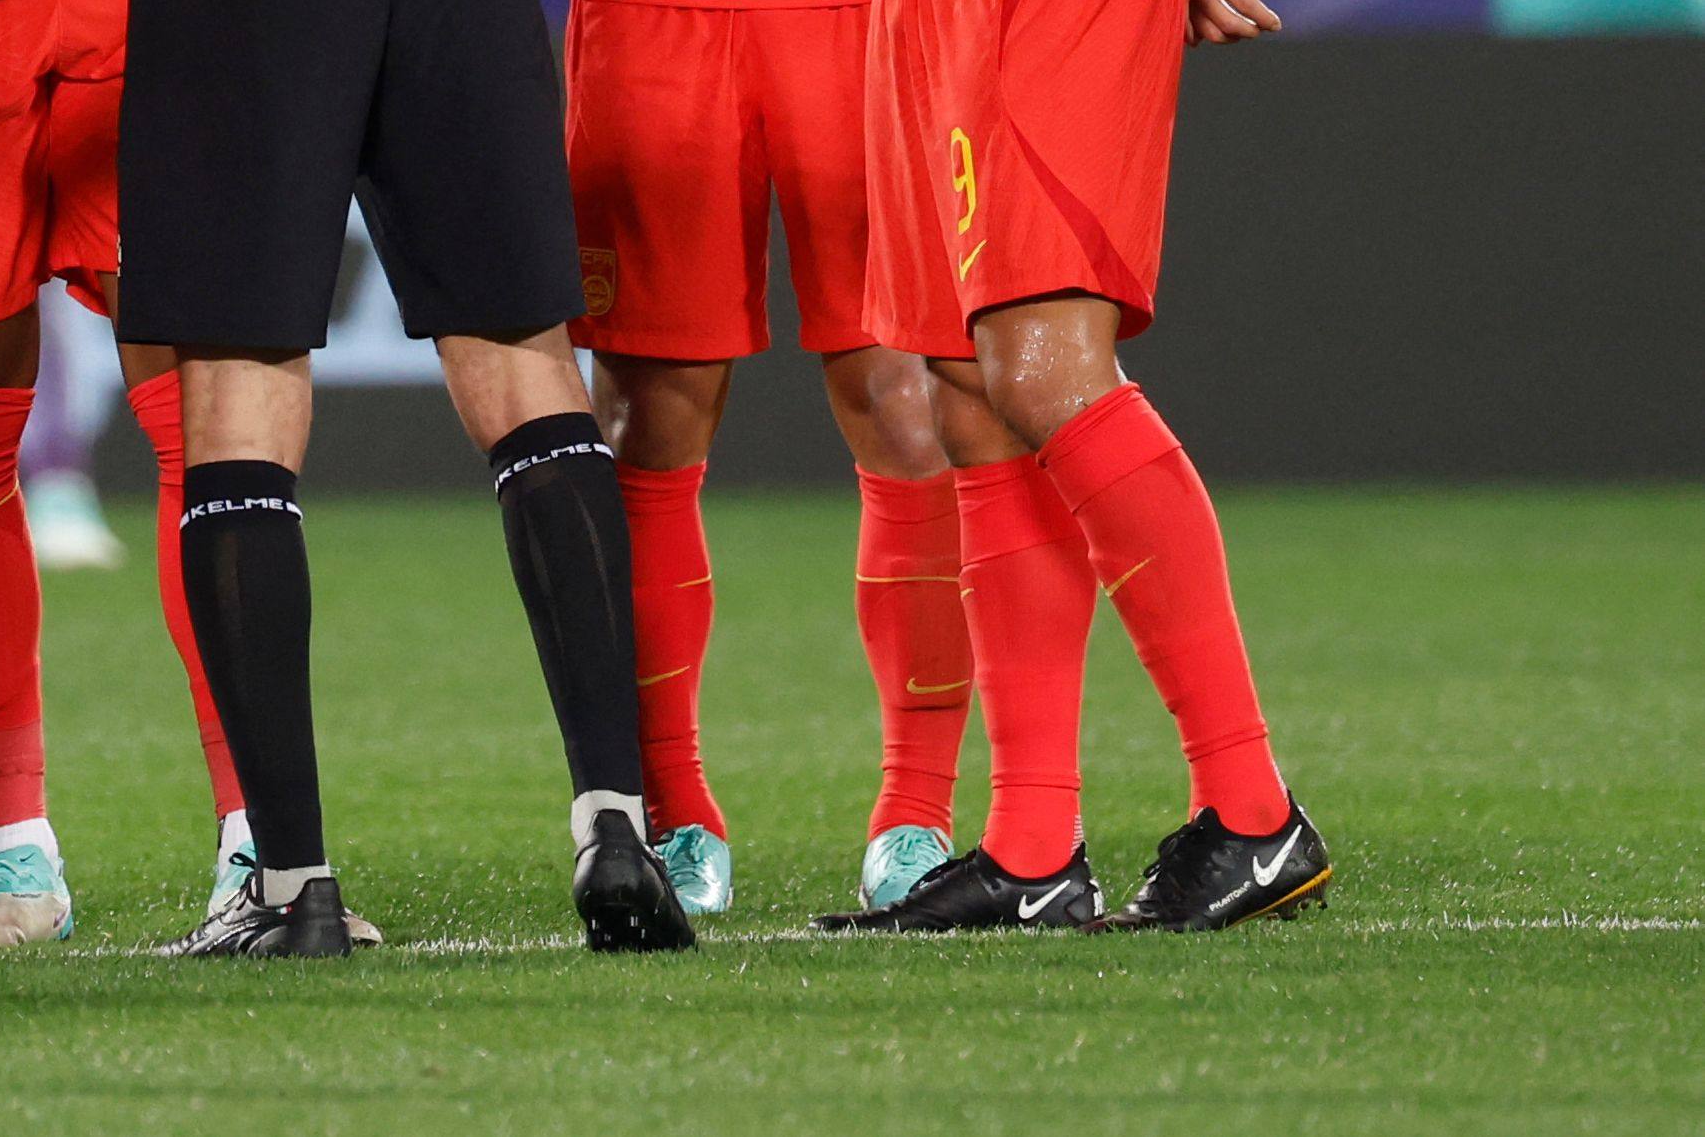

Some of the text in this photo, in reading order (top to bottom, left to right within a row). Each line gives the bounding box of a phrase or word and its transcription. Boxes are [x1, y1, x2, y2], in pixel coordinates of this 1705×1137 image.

[950, 126, 977, 236] 9
[498, 443, 593, 484] KELME
[190, 497, 284, 519] KELME
